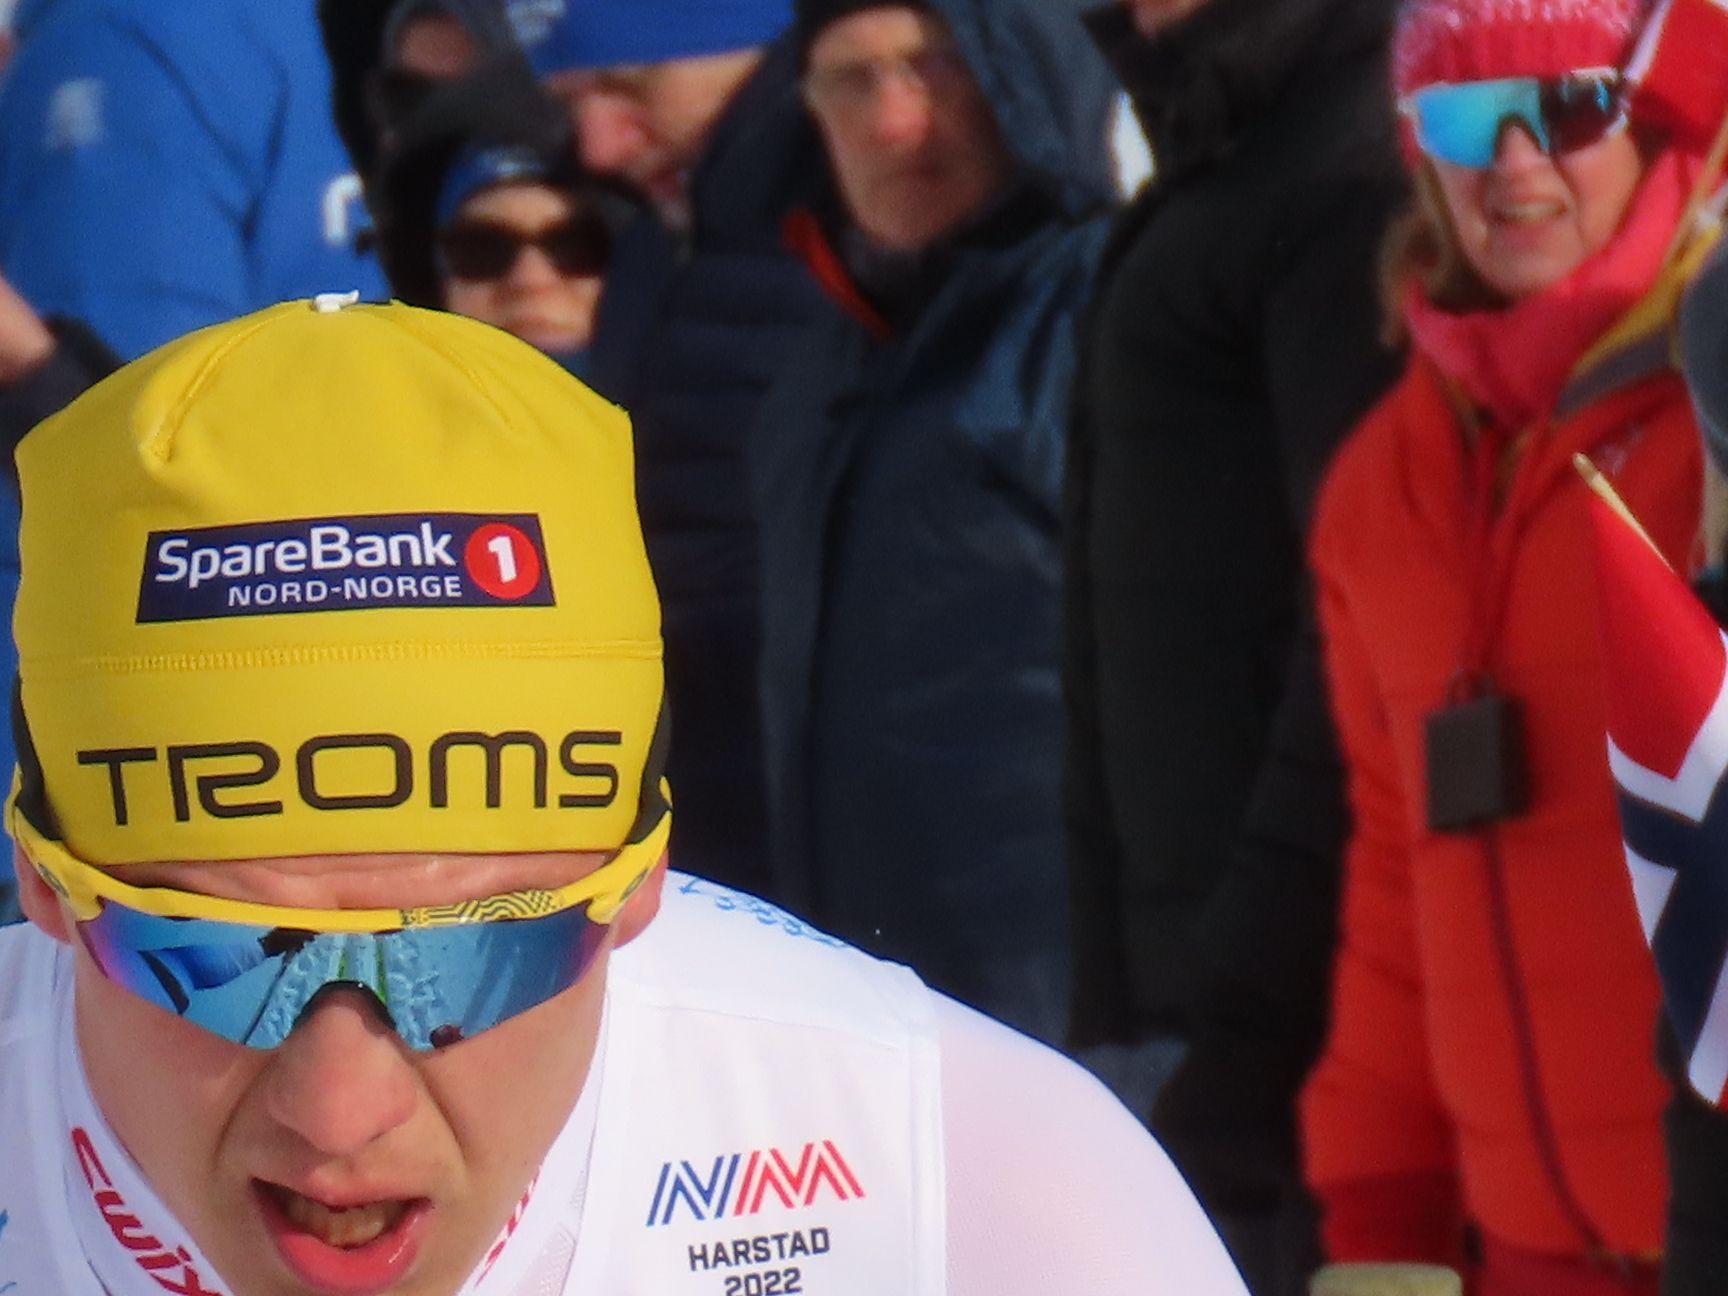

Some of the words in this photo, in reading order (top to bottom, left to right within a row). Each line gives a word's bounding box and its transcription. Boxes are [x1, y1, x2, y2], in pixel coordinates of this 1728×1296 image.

[155, 521, 456, 587] SpareBank
[487, 536, 518, 583] 1
[228, 576, 462, 606] NORD-NORGE
[77, 730, 622, 826] TROMS
[688, 1226, 832, 1272] HARSTAD
